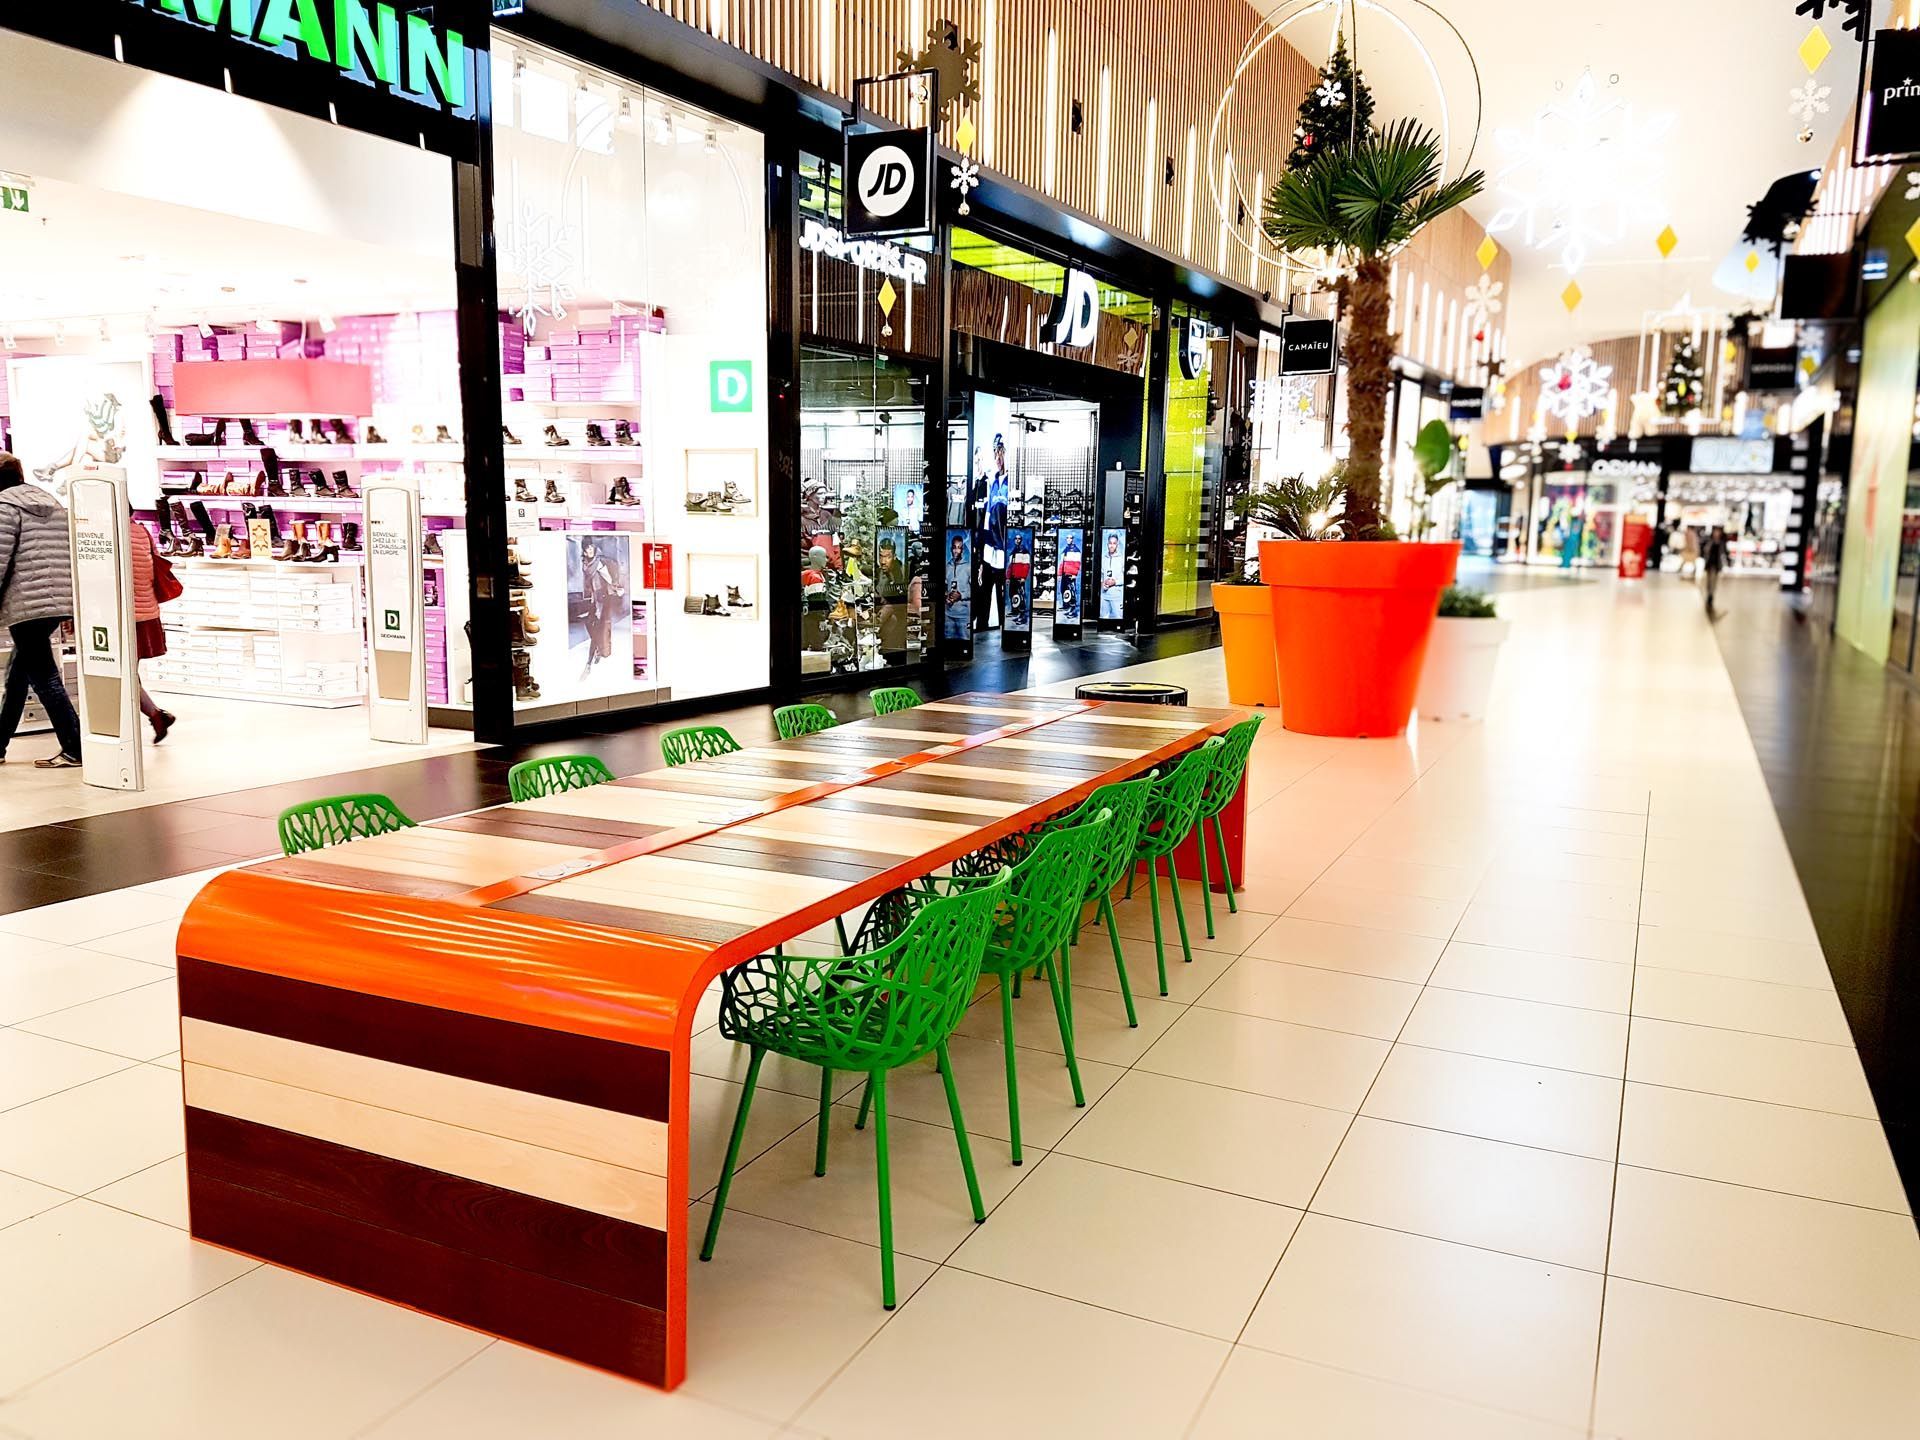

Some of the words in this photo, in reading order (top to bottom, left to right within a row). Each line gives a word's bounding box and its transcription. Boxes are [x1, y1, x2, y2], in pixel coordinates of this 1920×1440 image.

[161, 0, 464, 107] ANN
[867, 163, 906, 198] JD
[1055, 268, 1099, 347] JD
[1288, 341, 1329, 351] CAMAÏEU
[716, 366, 749, 406] D
[386, 612, 399, 628] D
[94, 629, 107, 649] D
